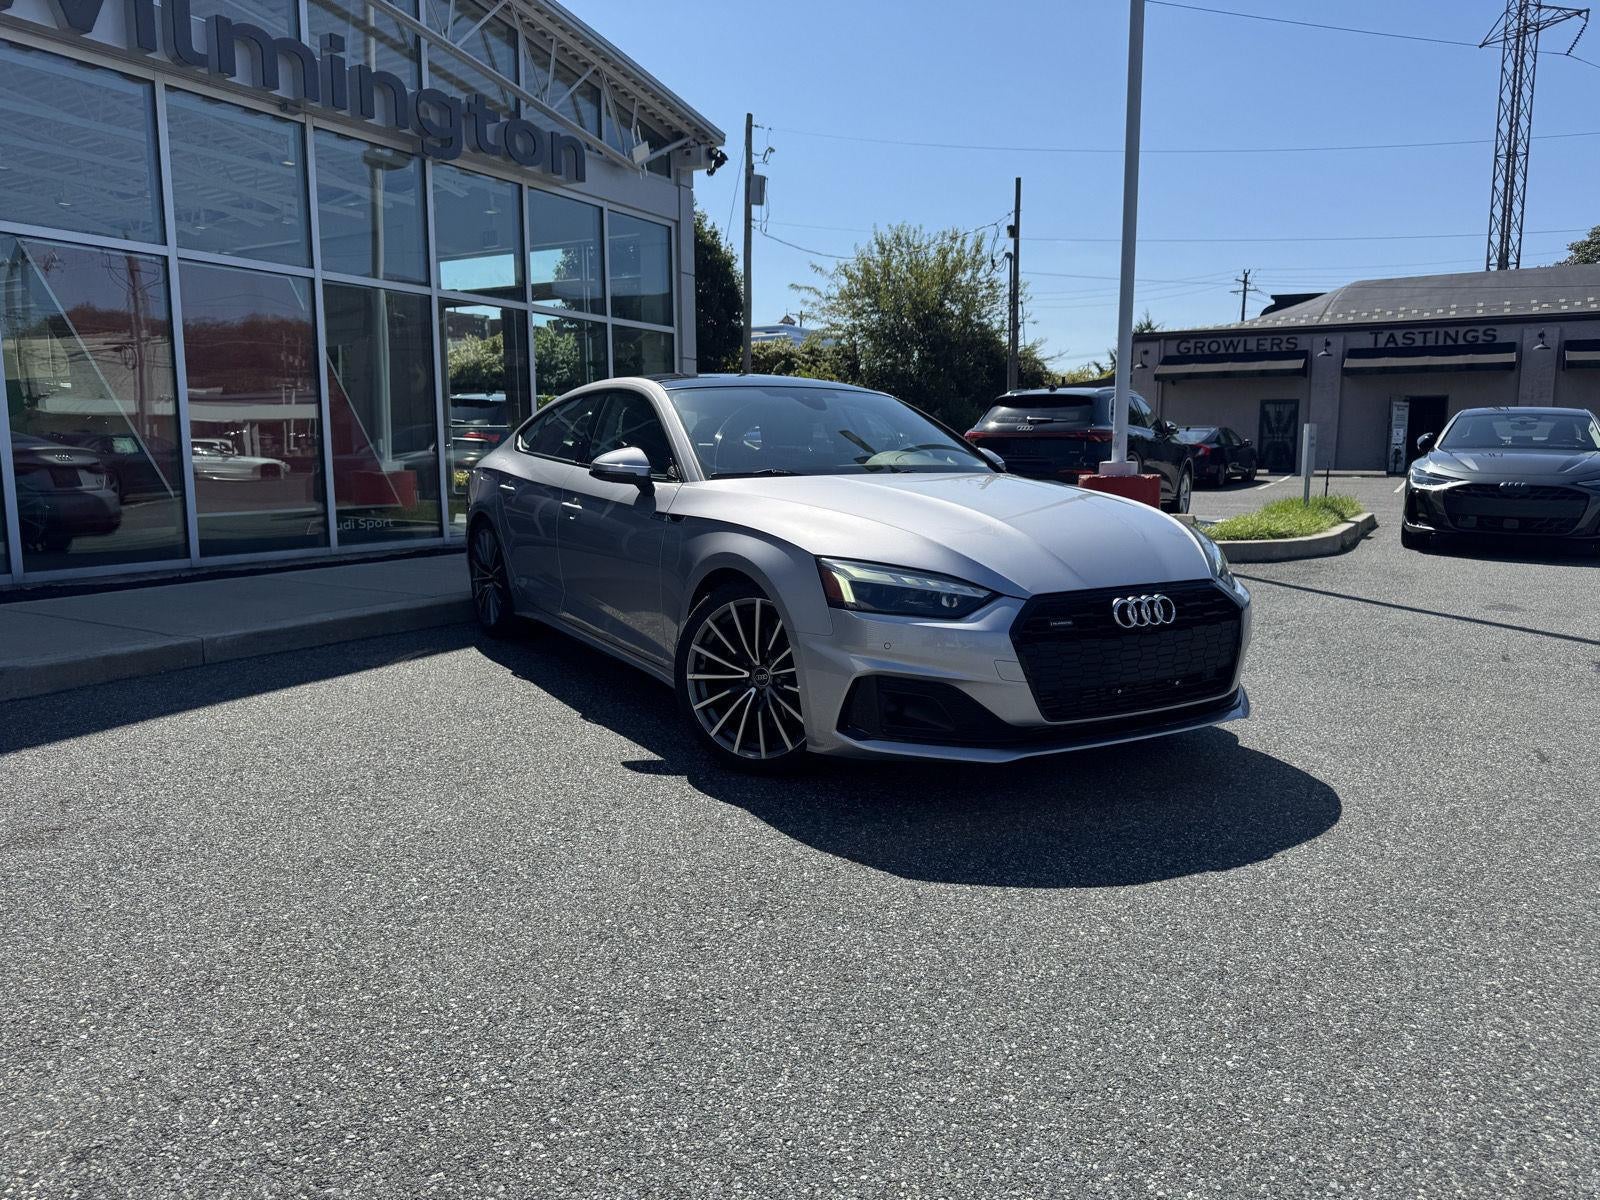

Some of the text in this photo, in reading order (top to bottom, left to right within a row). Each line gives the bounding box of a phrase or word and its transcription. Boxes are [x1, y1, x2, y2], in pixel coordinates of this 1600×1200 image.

[0, 0, 586, 182] ilmington
[1176, 336, 1299, 354] GROWLERS
[1369, 327, 1497, 347] TASTINGS
[359, 518, 393, 530] Sport
